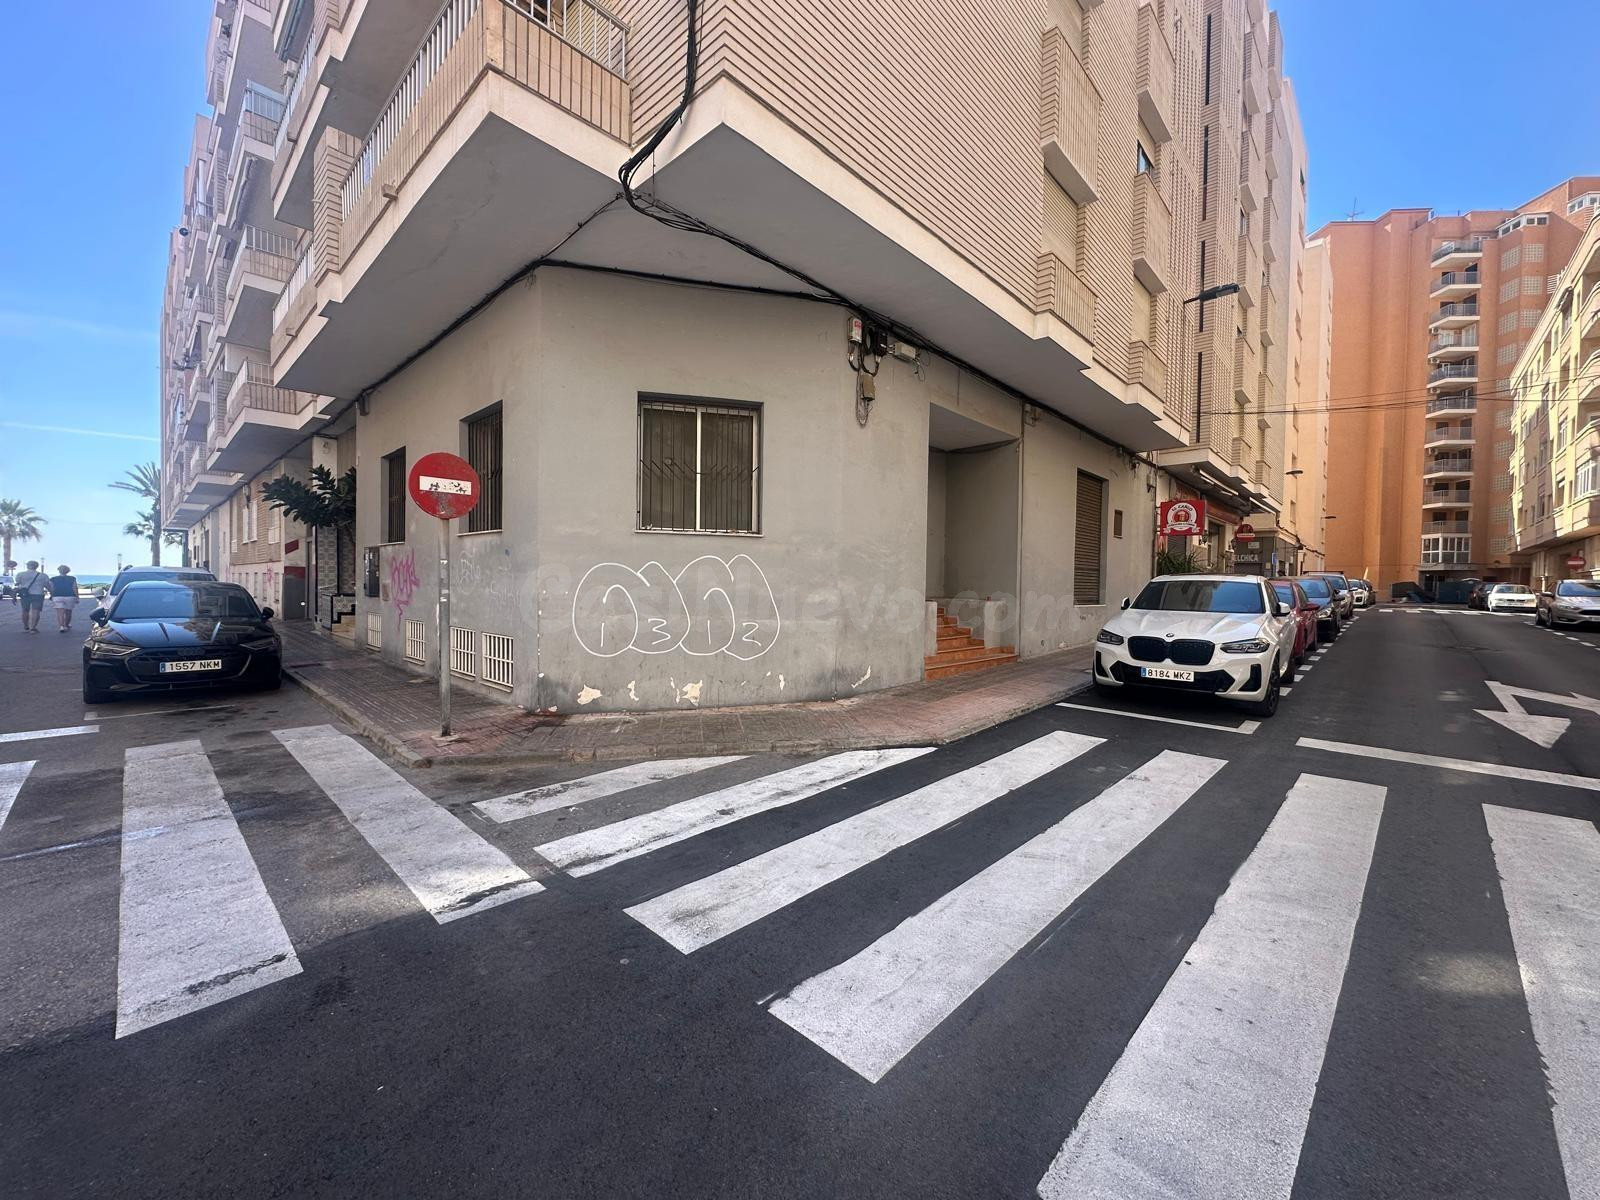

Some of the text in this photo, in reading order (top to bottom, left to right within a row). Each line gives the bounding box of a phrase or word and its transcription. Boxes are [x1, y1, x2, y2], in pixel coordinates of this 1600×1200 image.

[169, 661, 220, 670] 1557 NKM
[1147, 668, 1191, 680] 8184 MKZ
